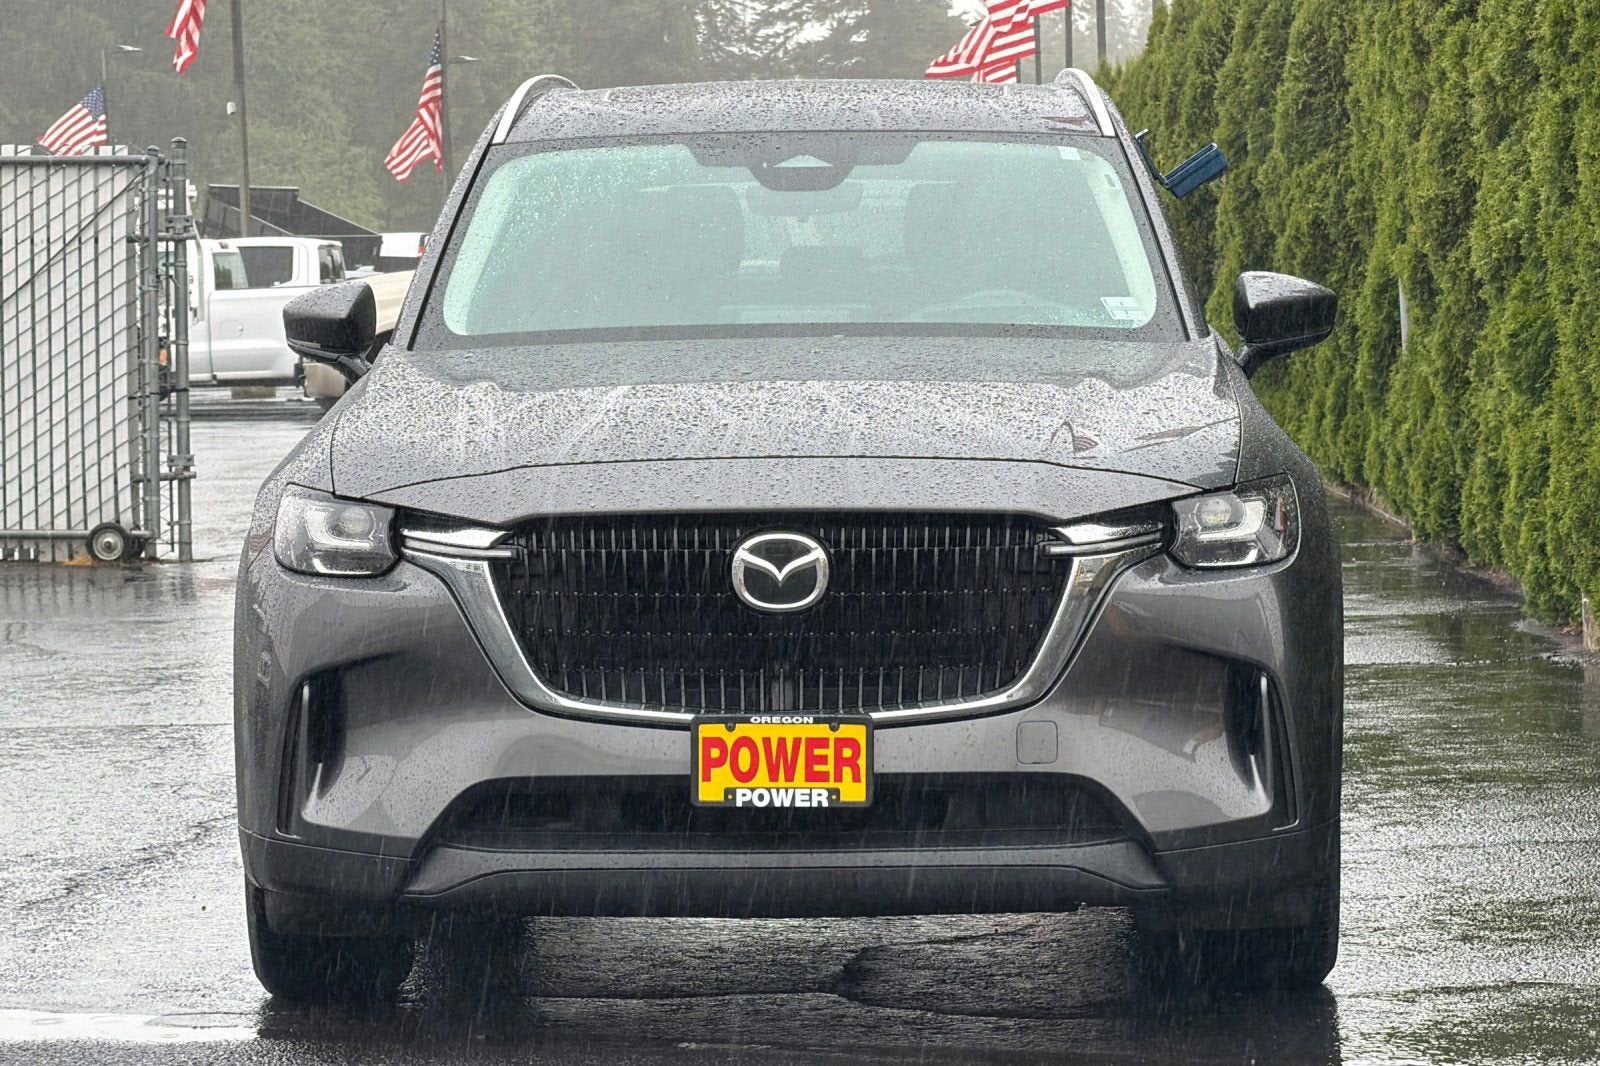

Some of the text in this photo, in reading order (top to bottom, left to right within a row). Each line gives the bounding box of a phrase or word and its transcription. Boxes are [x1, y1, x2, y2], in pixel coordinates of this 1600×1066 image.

[750, 716, 814, 724] OREGON
[701, 735, 862, 783] POWER
[735, 787, 829, 808] POWER
